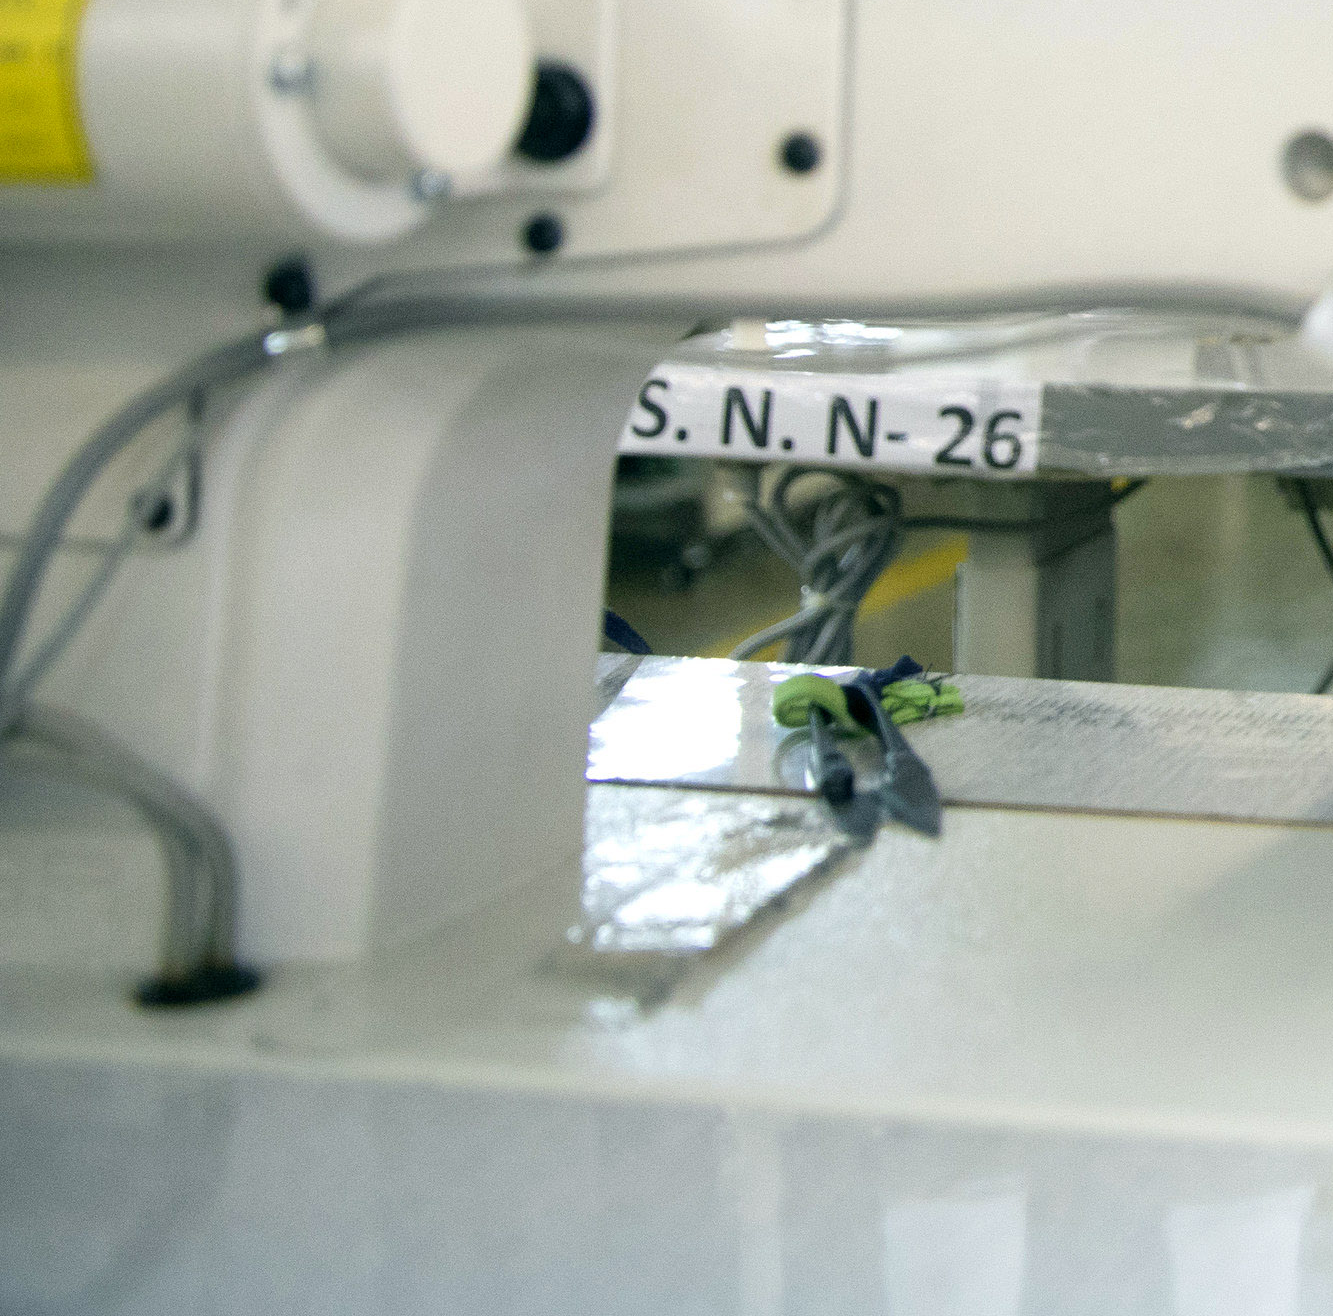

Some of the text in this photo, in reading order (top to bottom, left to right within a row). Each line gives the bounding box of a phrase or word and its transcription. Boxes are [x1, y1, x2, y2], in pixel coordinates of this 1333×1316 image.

[631, 378, 688, 442] S.
[720, 385, 795, 451] N.
[933, 403, 1024, 471] 26
